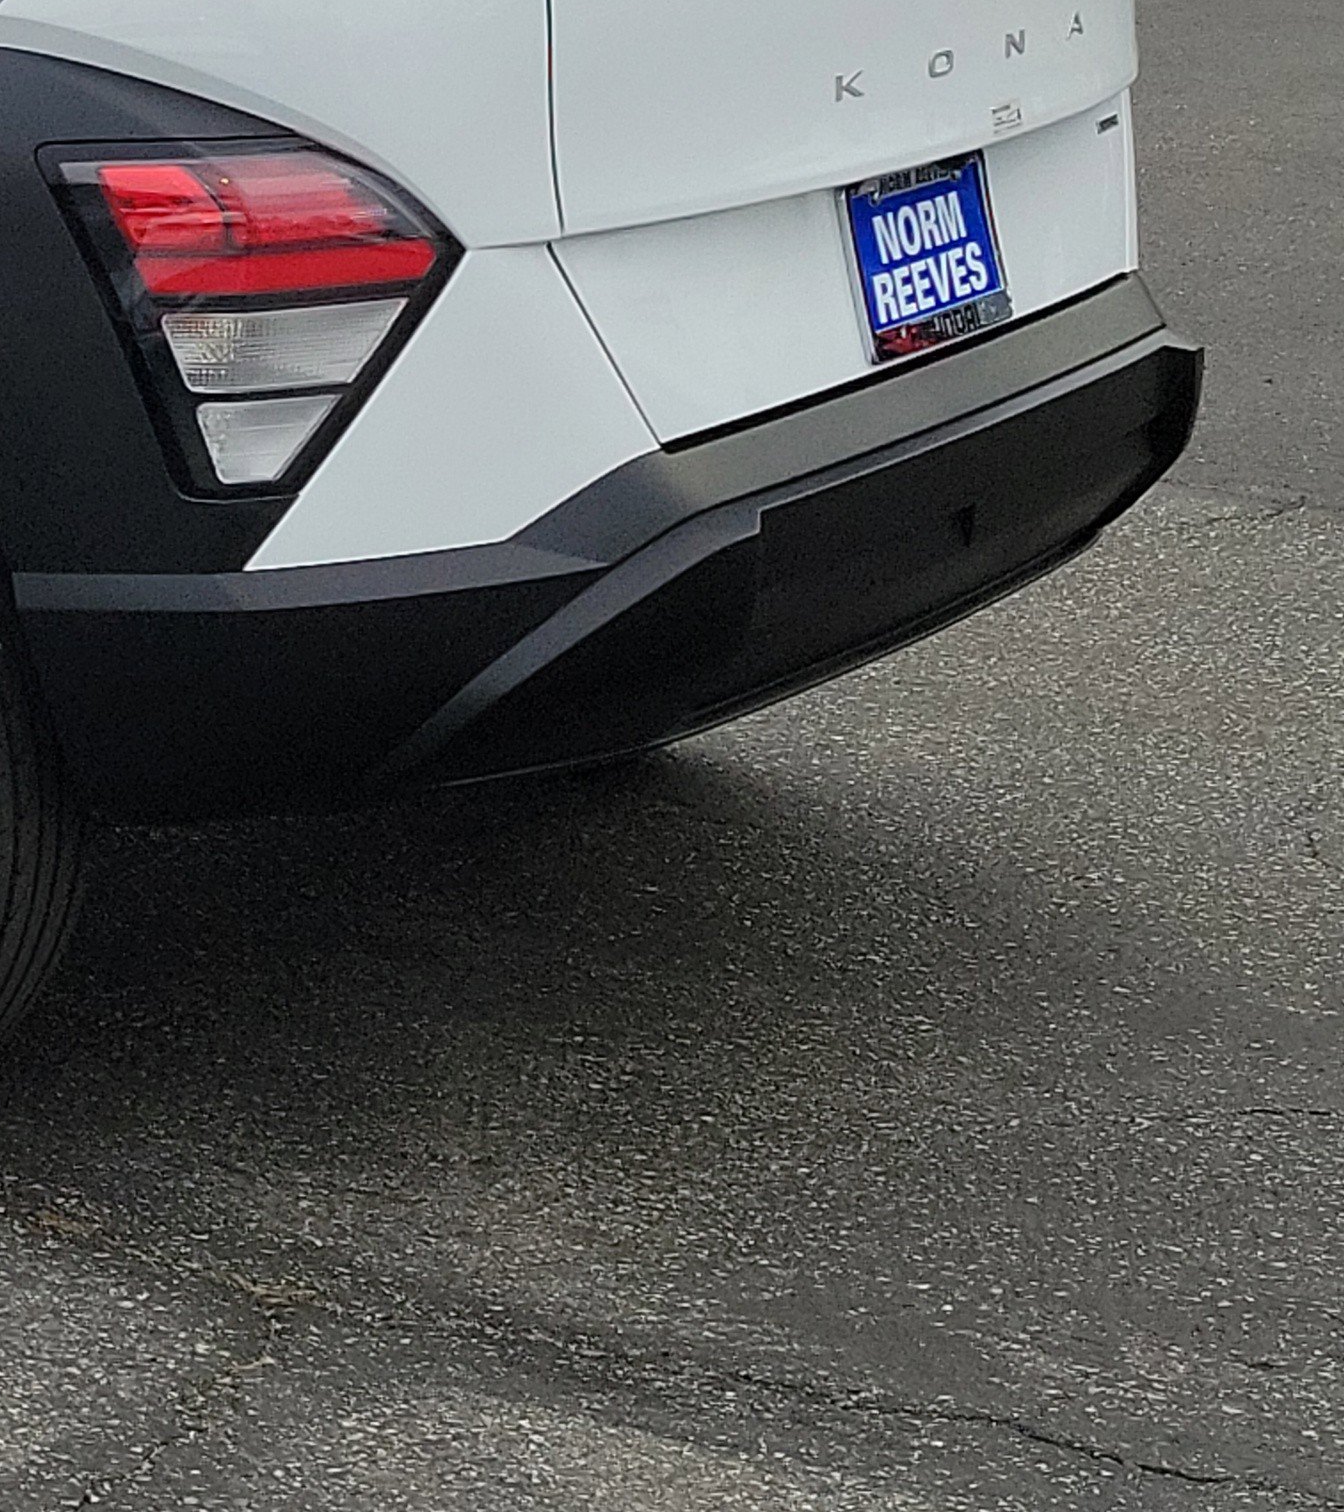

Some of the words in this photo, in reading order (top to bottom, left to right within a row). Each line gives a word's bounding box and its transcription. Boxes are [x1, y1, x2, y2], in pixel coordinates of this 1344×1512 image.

[834, 10, 1084, 103] KONA
[871, 190, 968, 265] NORM
[871, 241, 989, 325] REEVES
